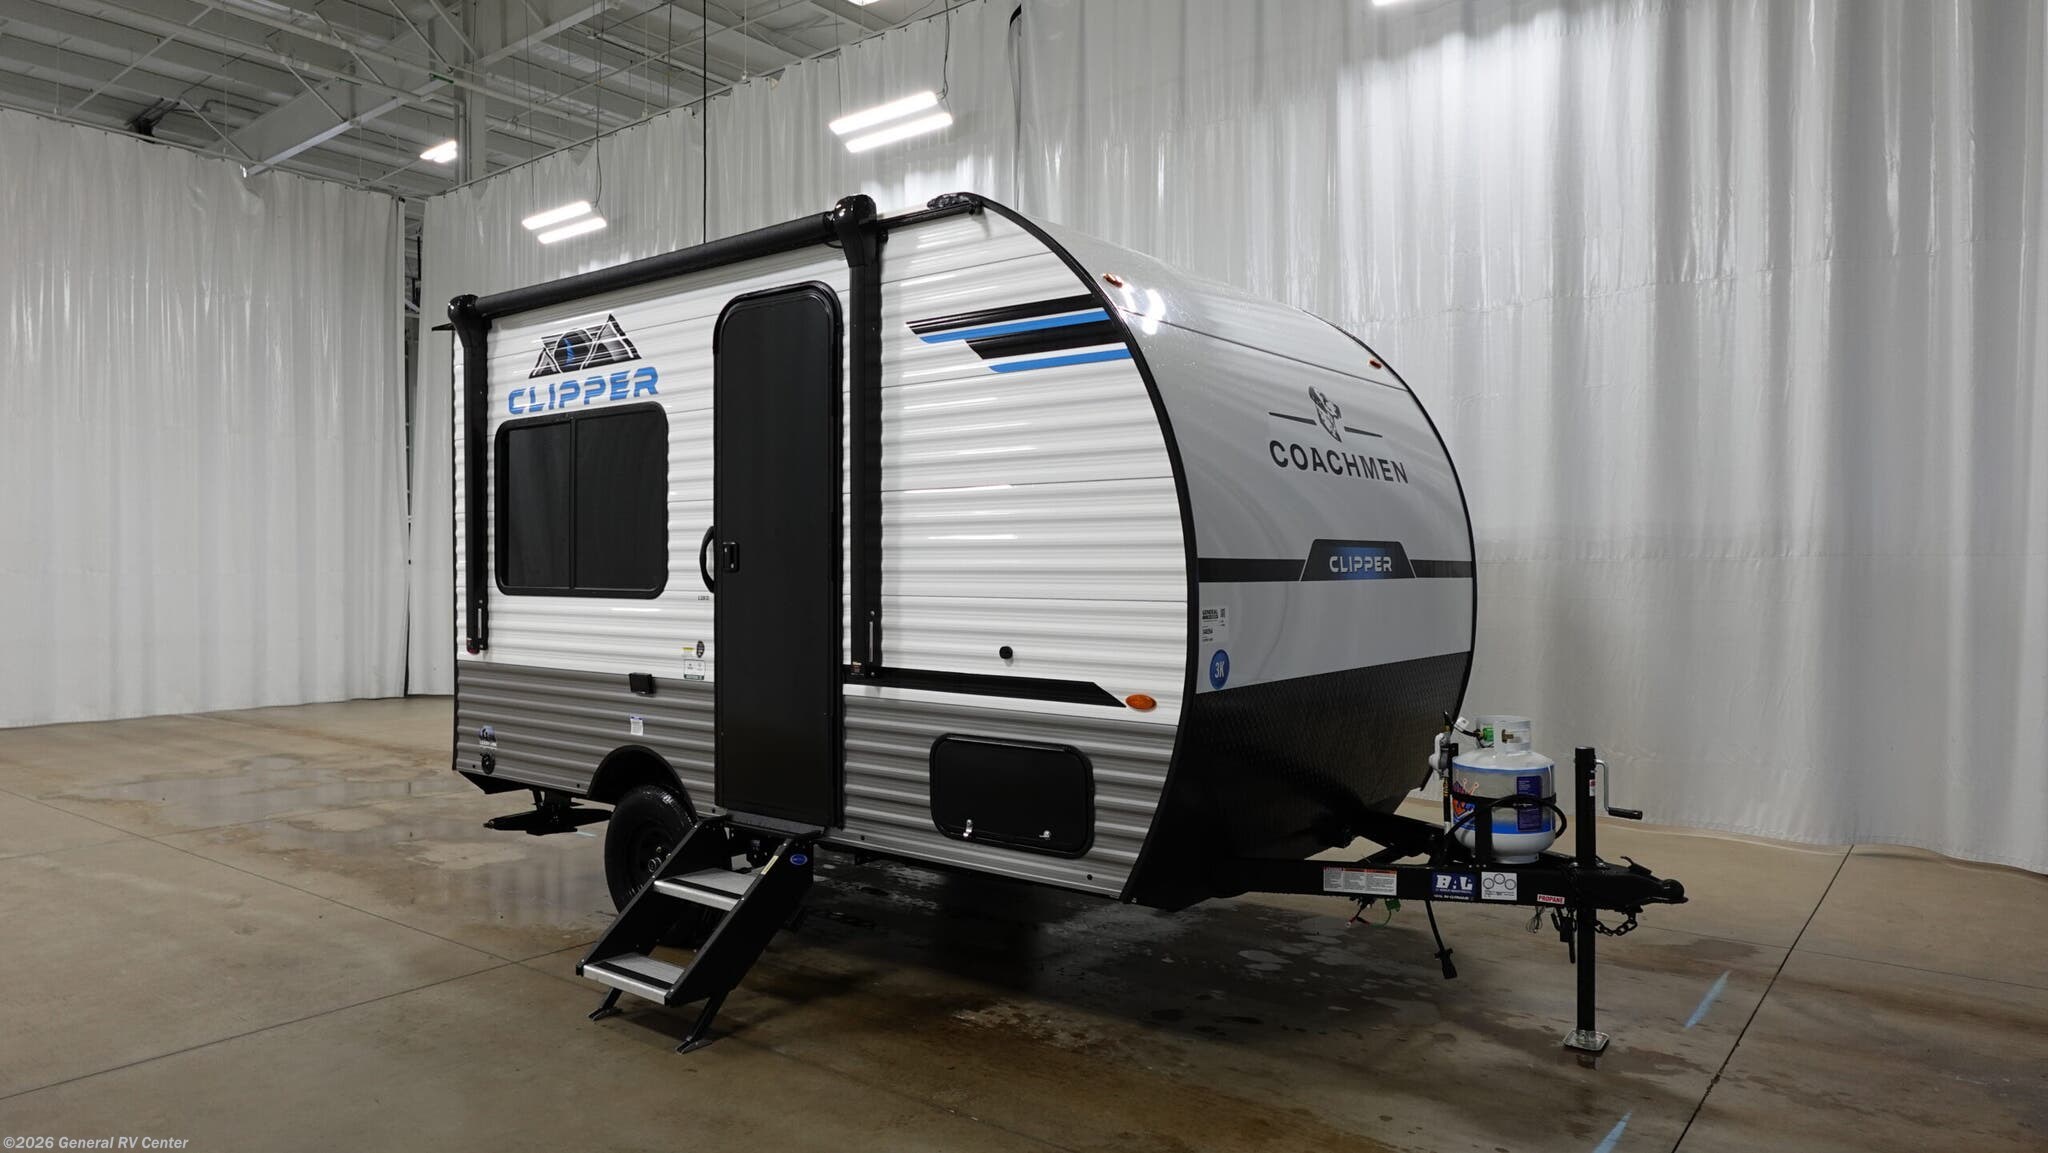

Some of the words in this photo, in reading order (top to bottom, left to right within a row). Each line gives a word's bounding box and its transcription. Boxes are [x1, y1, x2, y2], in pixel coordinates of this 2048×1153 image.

[508, 366, 659, 415] CLIPPER
[1269, 440, 1409, 484] COACHMEN
[1329, 556, 1393, 573] CLIPPER
[1214, 661, 1225, 679] 3K
